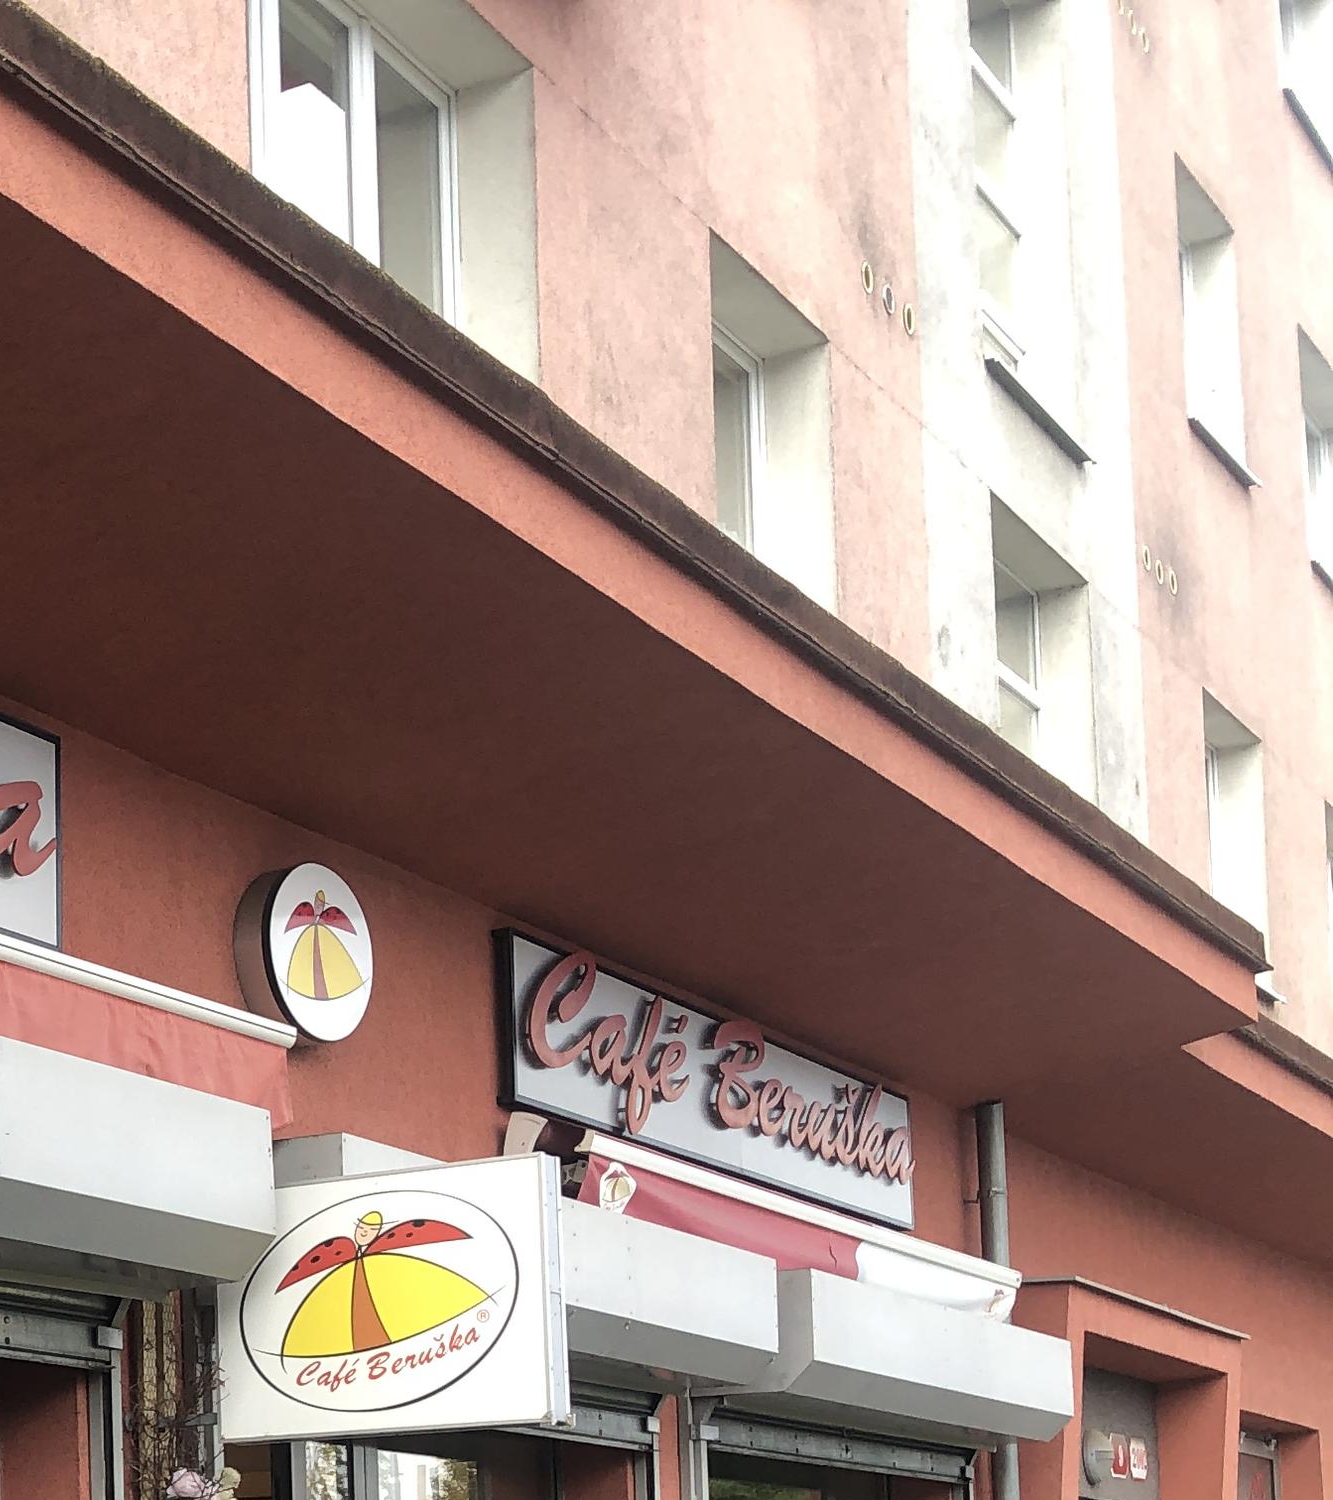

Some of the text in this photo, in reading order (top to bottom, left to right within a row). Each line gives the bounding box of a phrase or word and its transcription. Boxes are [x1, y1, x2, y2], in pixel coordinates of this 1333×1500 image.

[529, 950, 916, 1185] Café Beruška
[296, 1324, 481, 1393] Café Beruška
